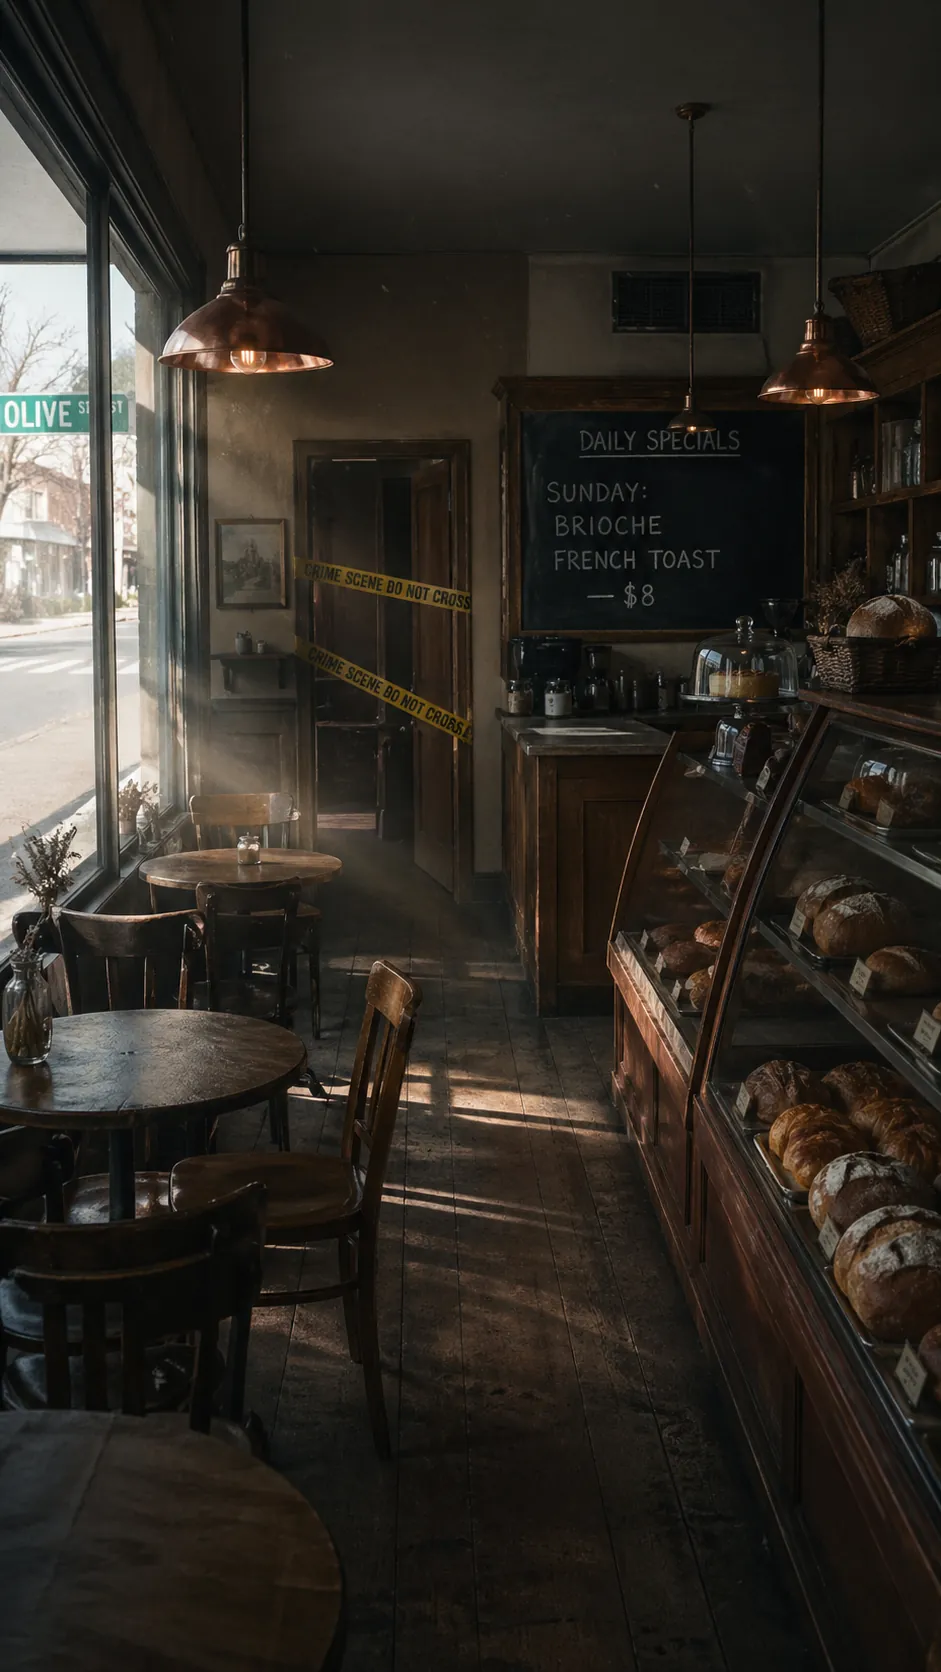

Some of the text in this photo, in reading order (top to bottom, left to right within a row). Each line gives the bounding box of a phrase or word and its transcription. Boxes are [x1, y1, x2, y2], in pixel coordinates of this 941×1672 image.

[4, 400, 73, 428] OLIVE
[579, 429, 741, 451] DAILY SPECIALS
[546, 481, 648, 504] SUNDAY:
[554, 514, 662, 537] BRIOCHE
[553, 549, 721, 571] FRENCH TOAST
[304, 563, 342, 583] CRIME
[344, 571, 384, 592] SCENE
[405, 583, 430, 601] NOT
[432, 589, 472, 610] CROSS
[623, 580, 656, 609] $8
[307, 646, 345, 675] CRIME
[345, 666, 384, 694] SCENE
[399, 693, 426, 715] NOT
